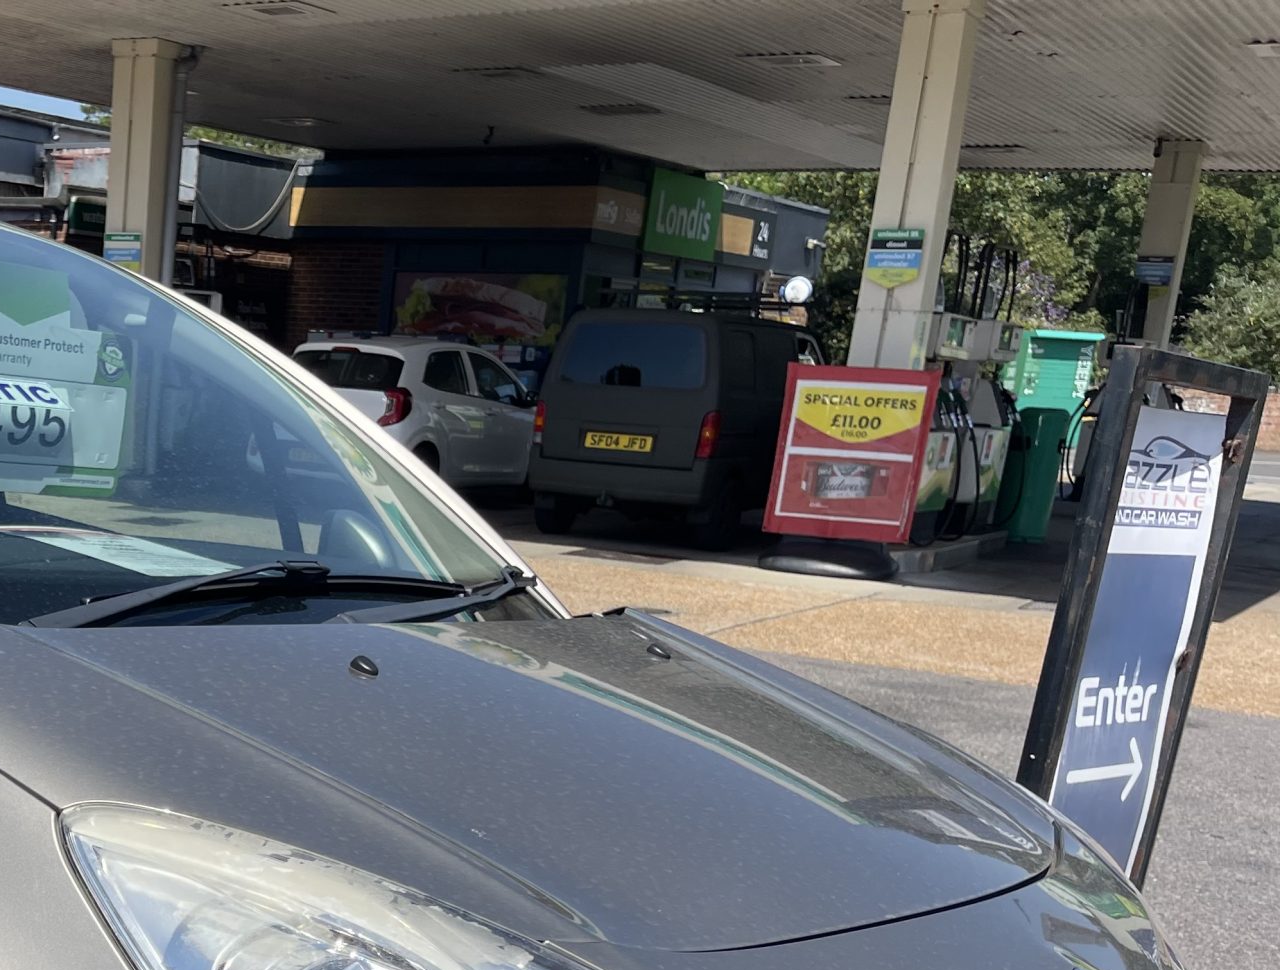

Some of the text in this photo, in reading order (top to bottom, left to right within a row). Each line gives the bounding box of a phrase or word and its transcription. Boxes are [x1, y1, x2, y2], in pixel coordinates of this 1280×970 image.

[655, 190, 711, 242] Londis
[757, 221, 770, 243] 24
[43, 338, 85, 355] Protect
[804, 393, 918, 411] SPECIAL OFFERS
[830, 414, 882, 430] £11.00
[590, 434, 647, 450] SF04 JFD
[1124, 460, 1208, 493] AZZLE
[1121, 491, 1206, 508] RISTINE
[1132, 509, 1157, 525] CAR
[1158, 510, 1199, 527] WASH
[1074, 675, 1157, 729] Enter
